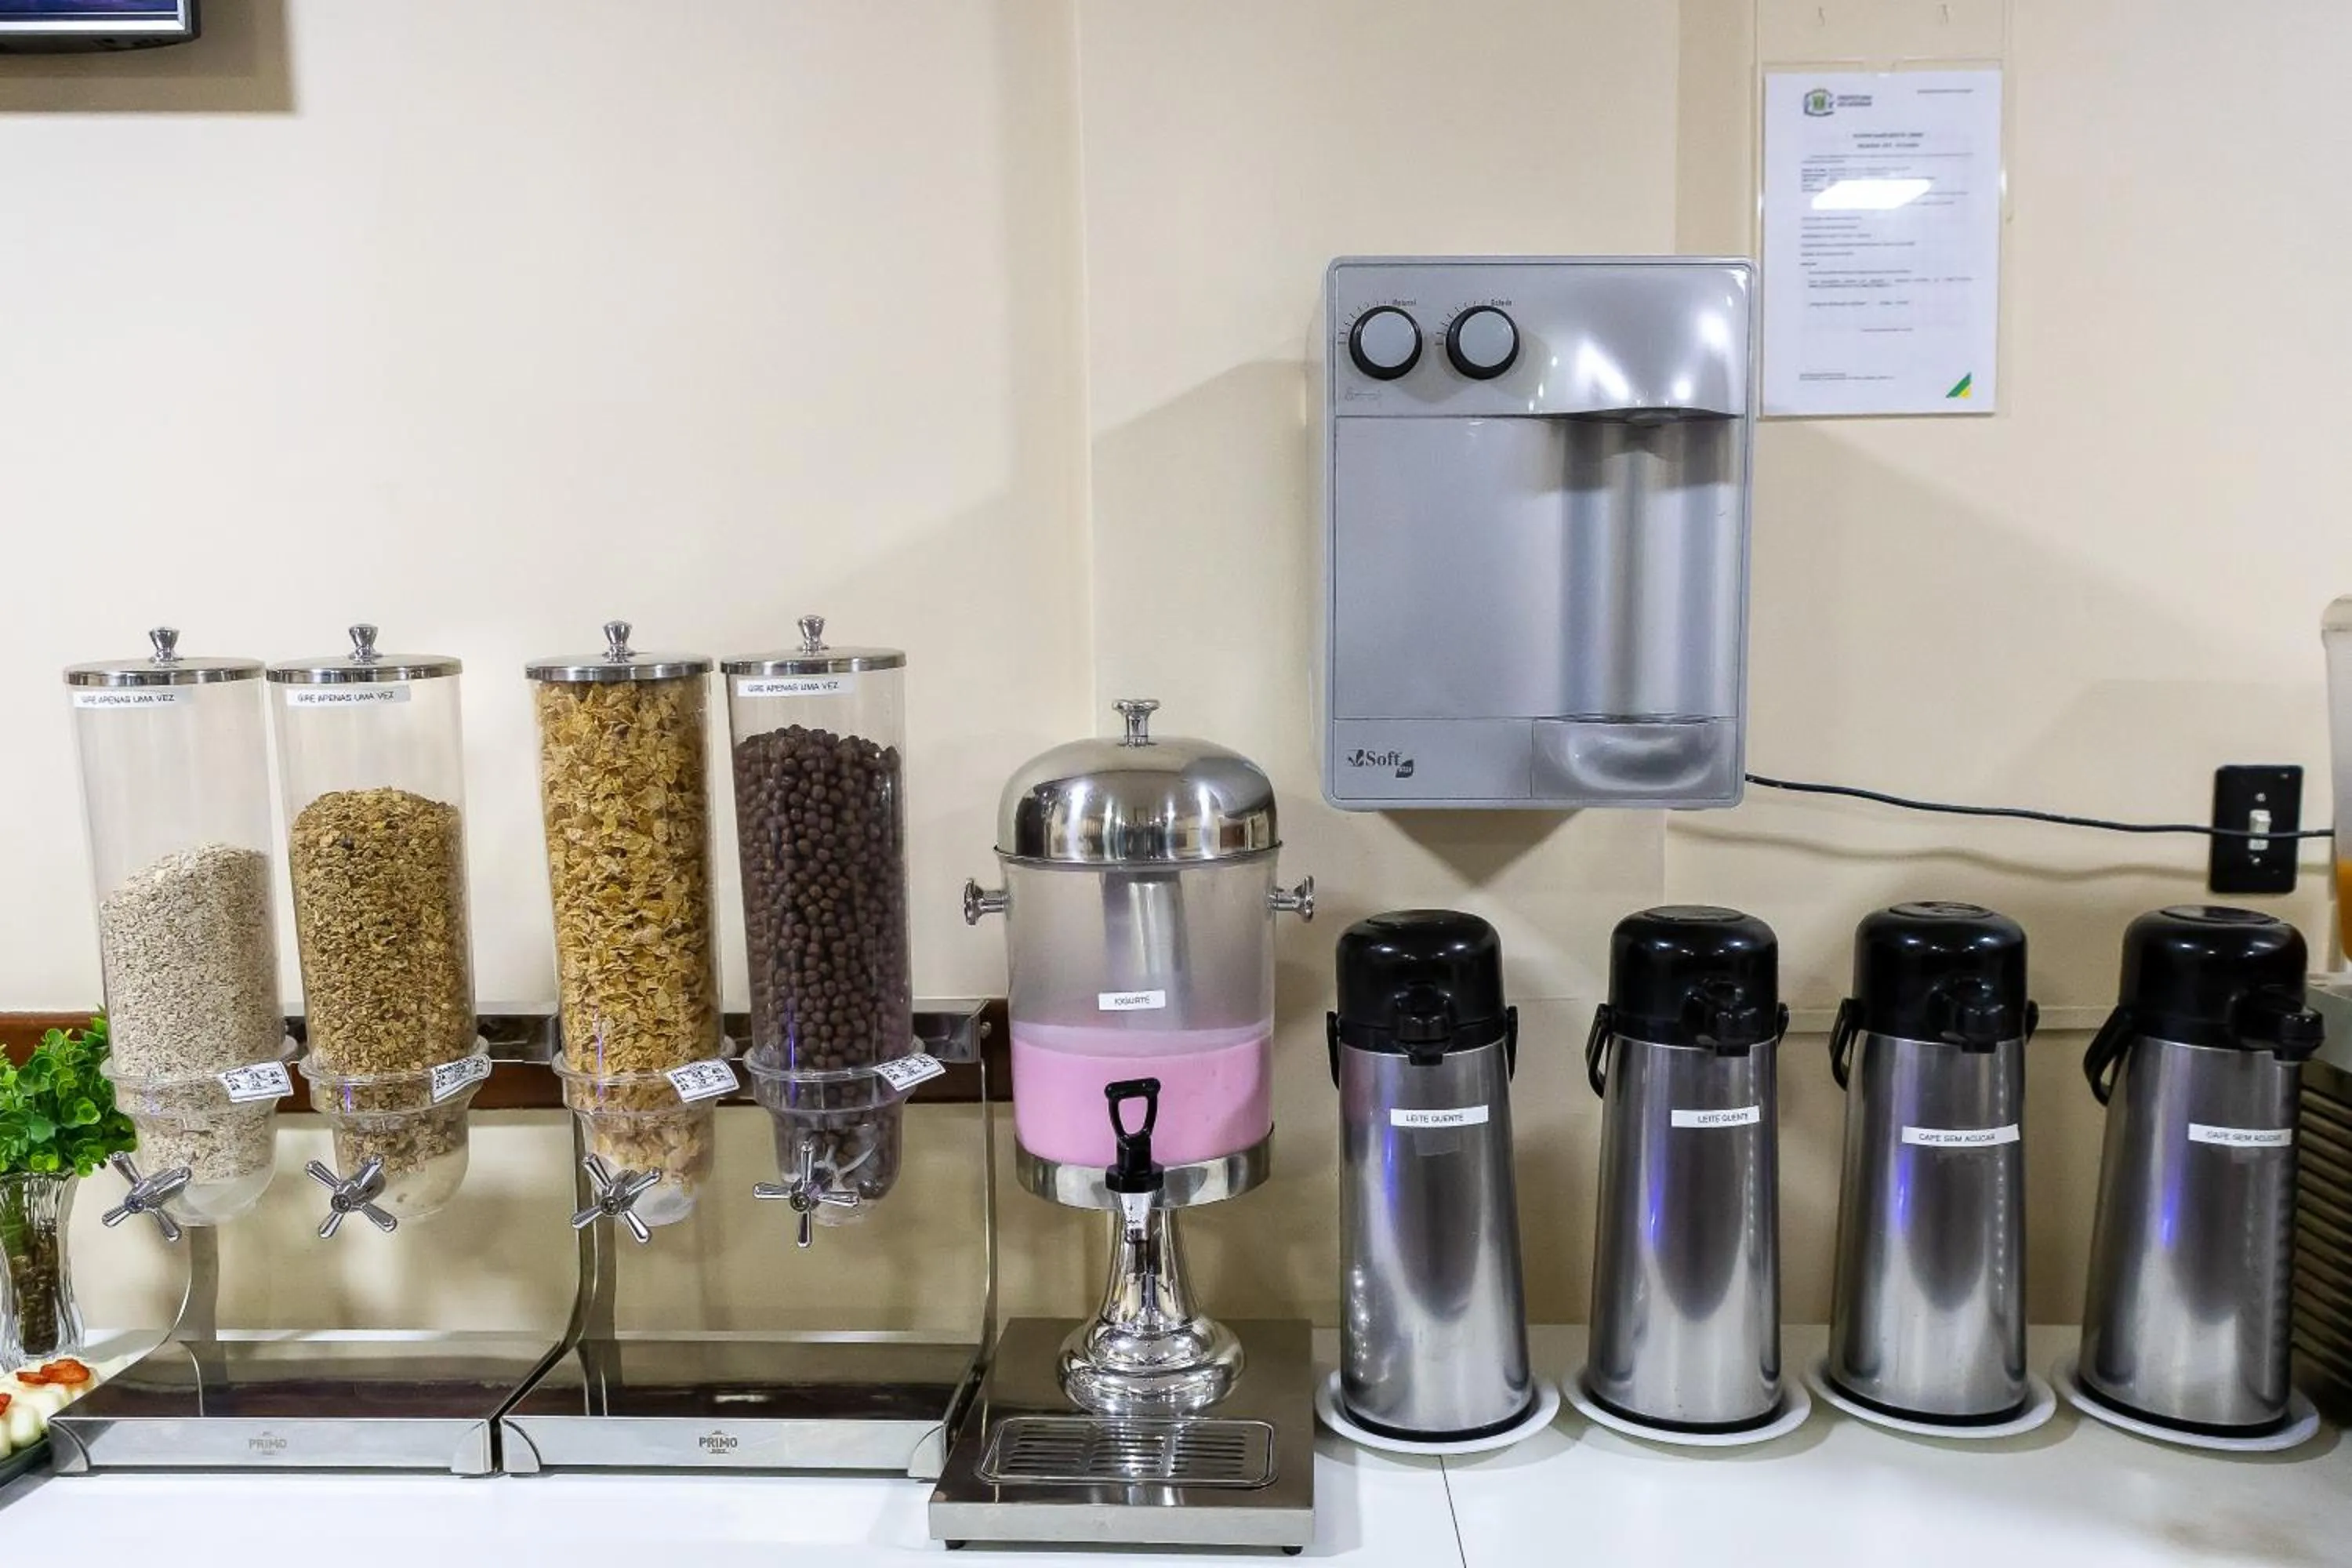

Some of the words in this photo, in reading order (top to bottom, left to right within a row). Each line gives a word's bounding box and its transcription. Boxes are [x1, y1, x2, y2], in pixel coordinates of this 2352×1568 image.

[821, 681, 839, 690] VEZ
[376, 691, 394, 700] VEZ
[1365, 750, 1403, 767] Soft
[1406, 1114, 1429, 1123] LEITE
[1431, 1114, 1464, 1123] QUENTE
[699, 1437, 738, 1448] PRIMO
